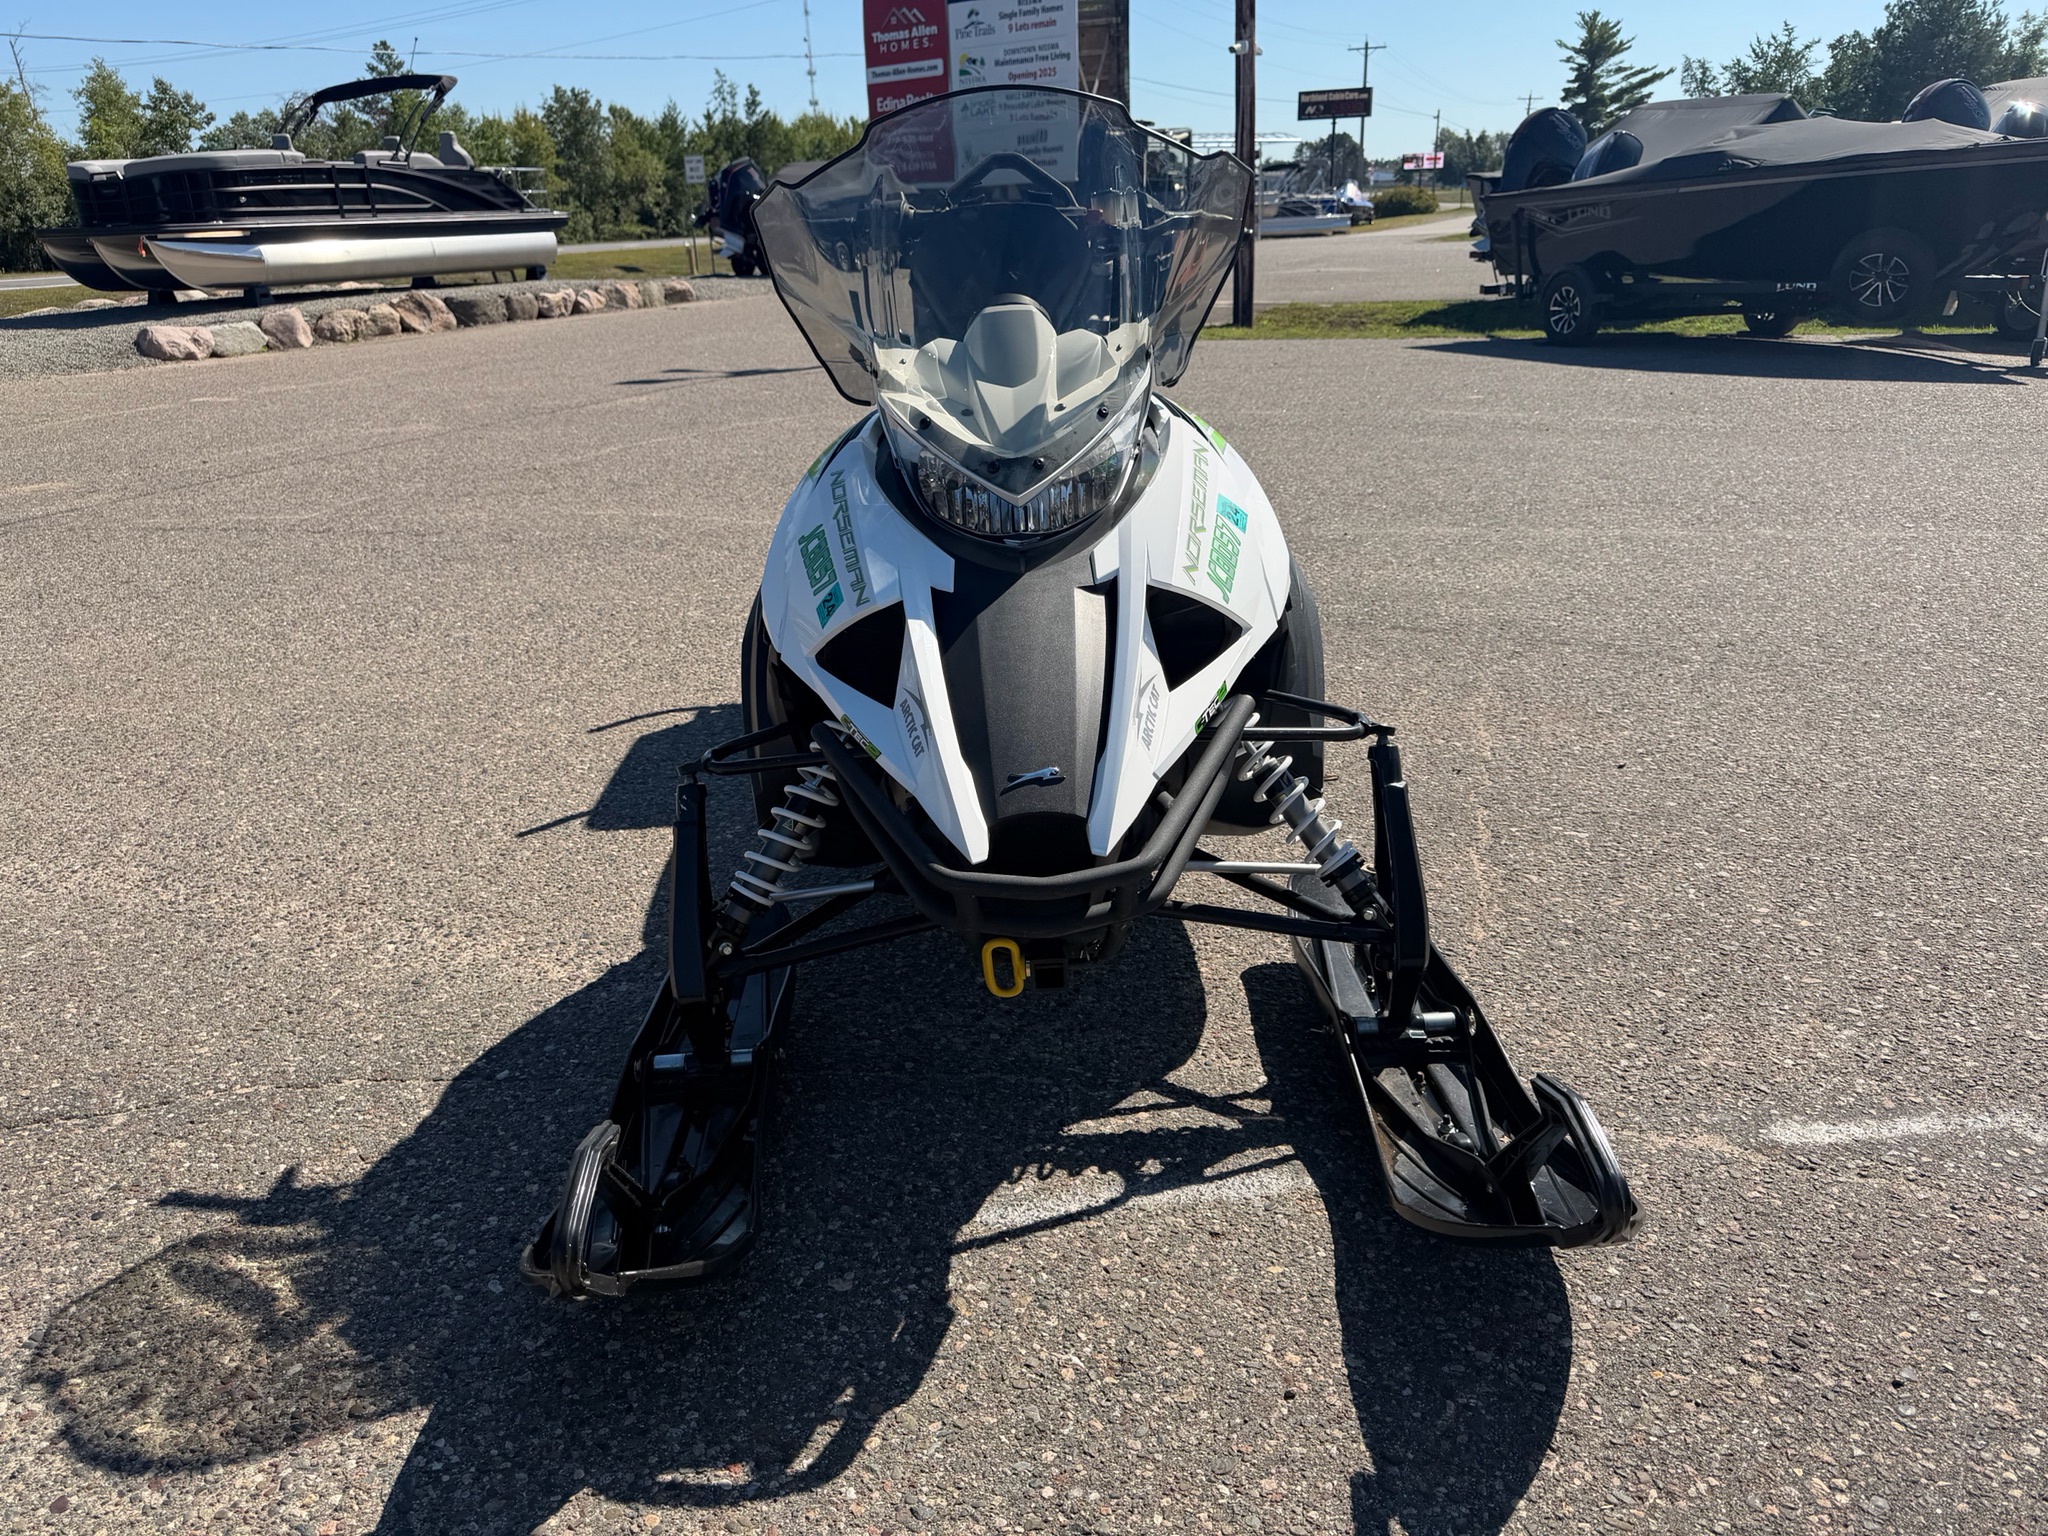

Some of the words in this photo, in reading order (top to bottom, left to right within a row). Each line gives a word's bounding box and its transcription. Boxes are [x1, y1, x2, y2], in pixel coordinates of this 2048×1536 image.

[998, 10, 1018, 21] Single
[1019, 7, 1040, 18] Family
[1041, 4, 1064, 14] Homes
[955, 27, 973, 40] Pine
[974, 24, 996, 37] Trails
[1007, 23, 1014, 33] 9
[1015, 21, 1030, 32] Lots
[1031, 17, 1057, 30] remain
[871, 29, 910, 44] Thomas
[911, 24, 938, 38] Allen
[994, 56, 1034, 67] Maintenance
[1035, 53, 1049, 62] Free
[1050, 51, 1071, 62] Living
[1007, 69, 1037, 82] Opening
[1038, 66, 1057, 77] 2025
[1567, 205, 1611, 222] LUND
[1776, 282, 1817, 292] LUND
[1182, 439, 1209, 586] NORSEMAN
[830, 468, 871, 608] NORSEMAN
[822, 592, 836, 617] 24
[1141, 704, 1157, 752] ARCTIC
[1149, 683, 1160, 710] CAT
[900, 698, 918, 739] ARCTIC
[911, 734, 925, 758] CAT
